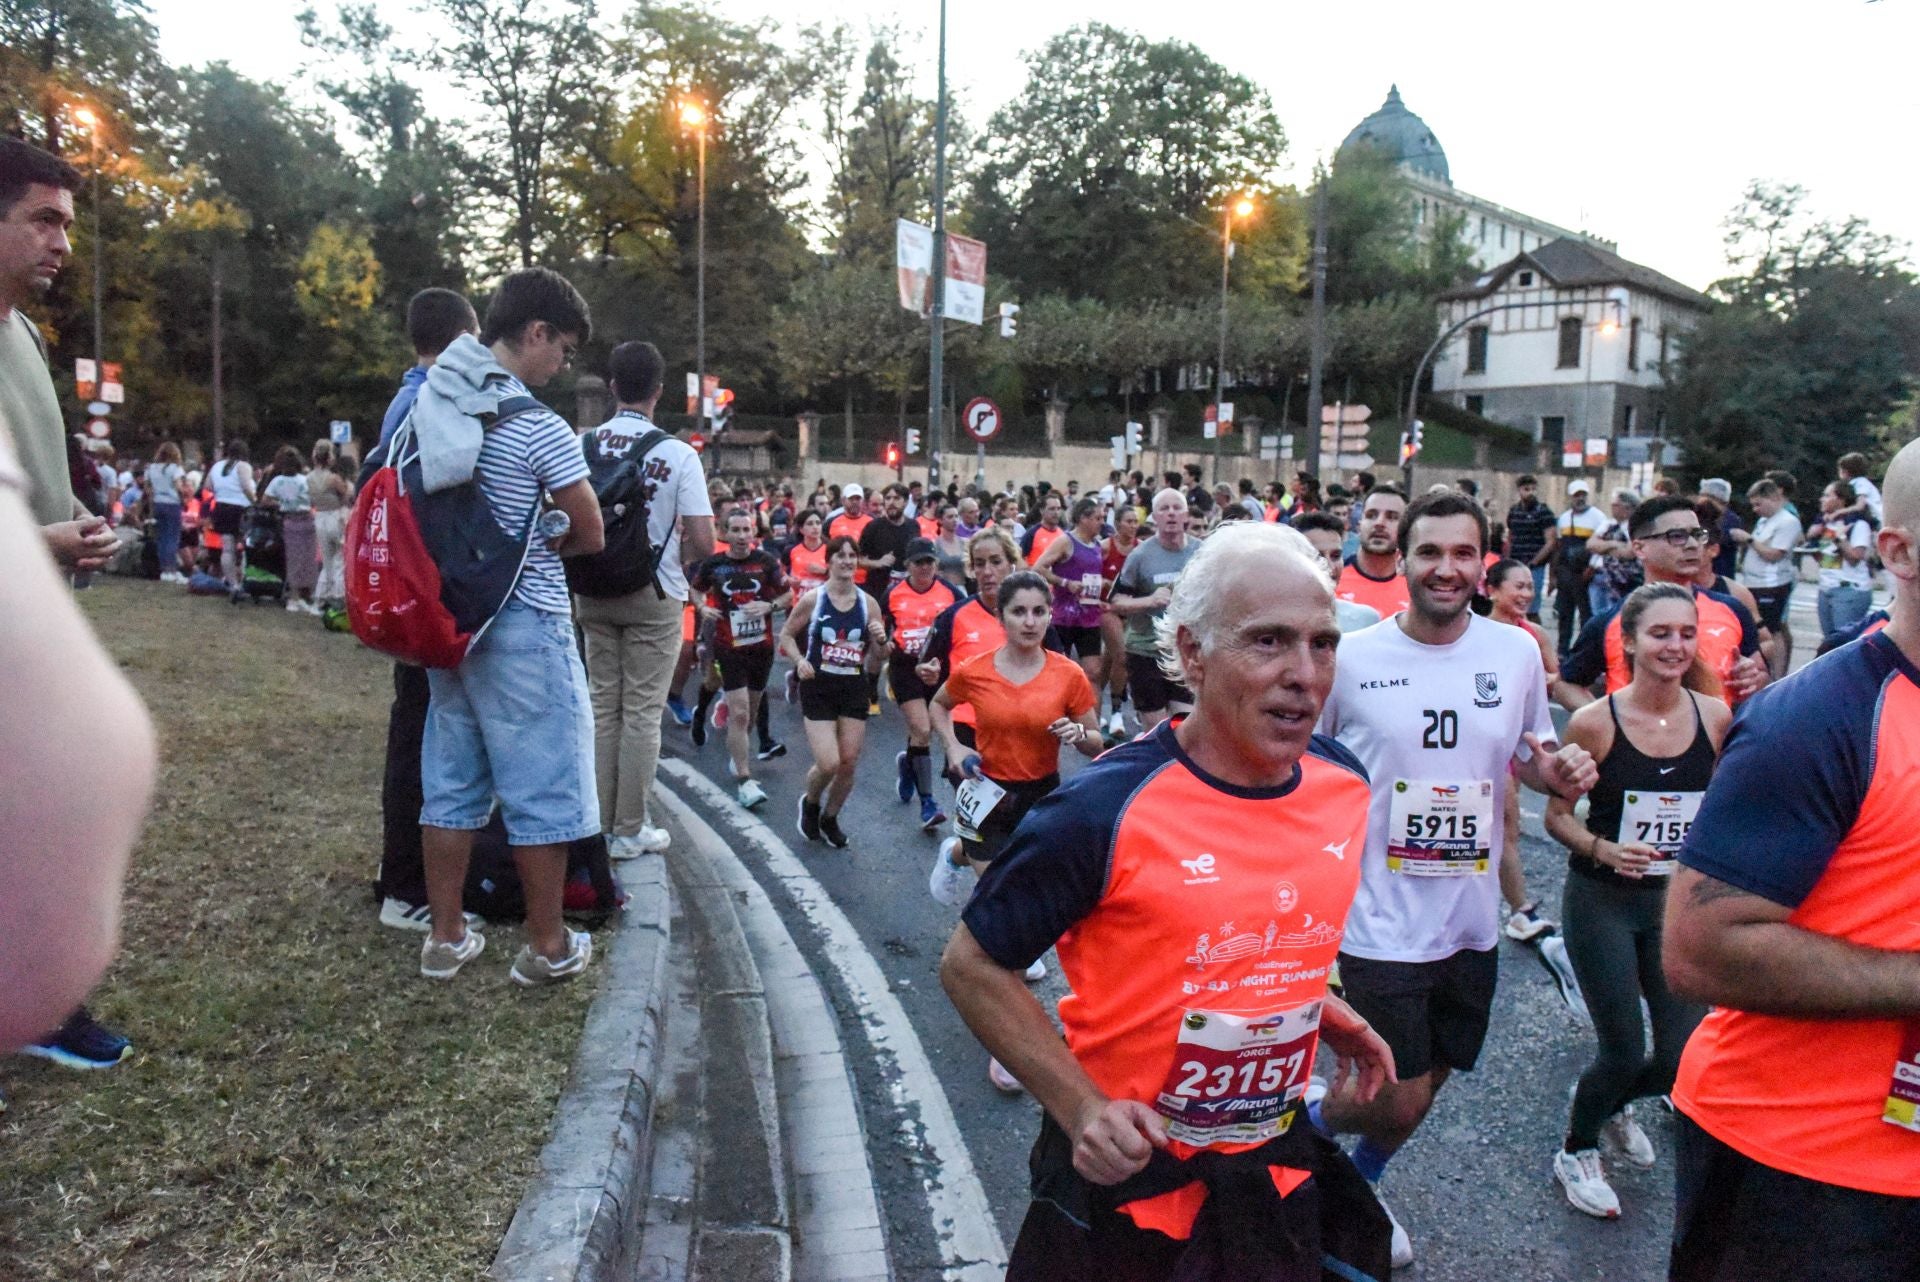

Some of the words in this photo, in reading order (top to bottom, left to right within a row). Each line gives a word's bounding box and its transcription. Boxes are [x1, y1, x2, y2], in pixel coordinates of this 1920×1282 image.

[1360, 678, 1410, 690] KELME
[1422, 709, 1458, 749] 20
[1406, 813, 1478, 839] 5915
[1239, 973, 1277, 988] NIGHT
[1279, 966, 1327, 984] RUNNING
[1236, 1047, 1273, 1059] JORGE
[1174, 1048, 1306, 1098] 23157
